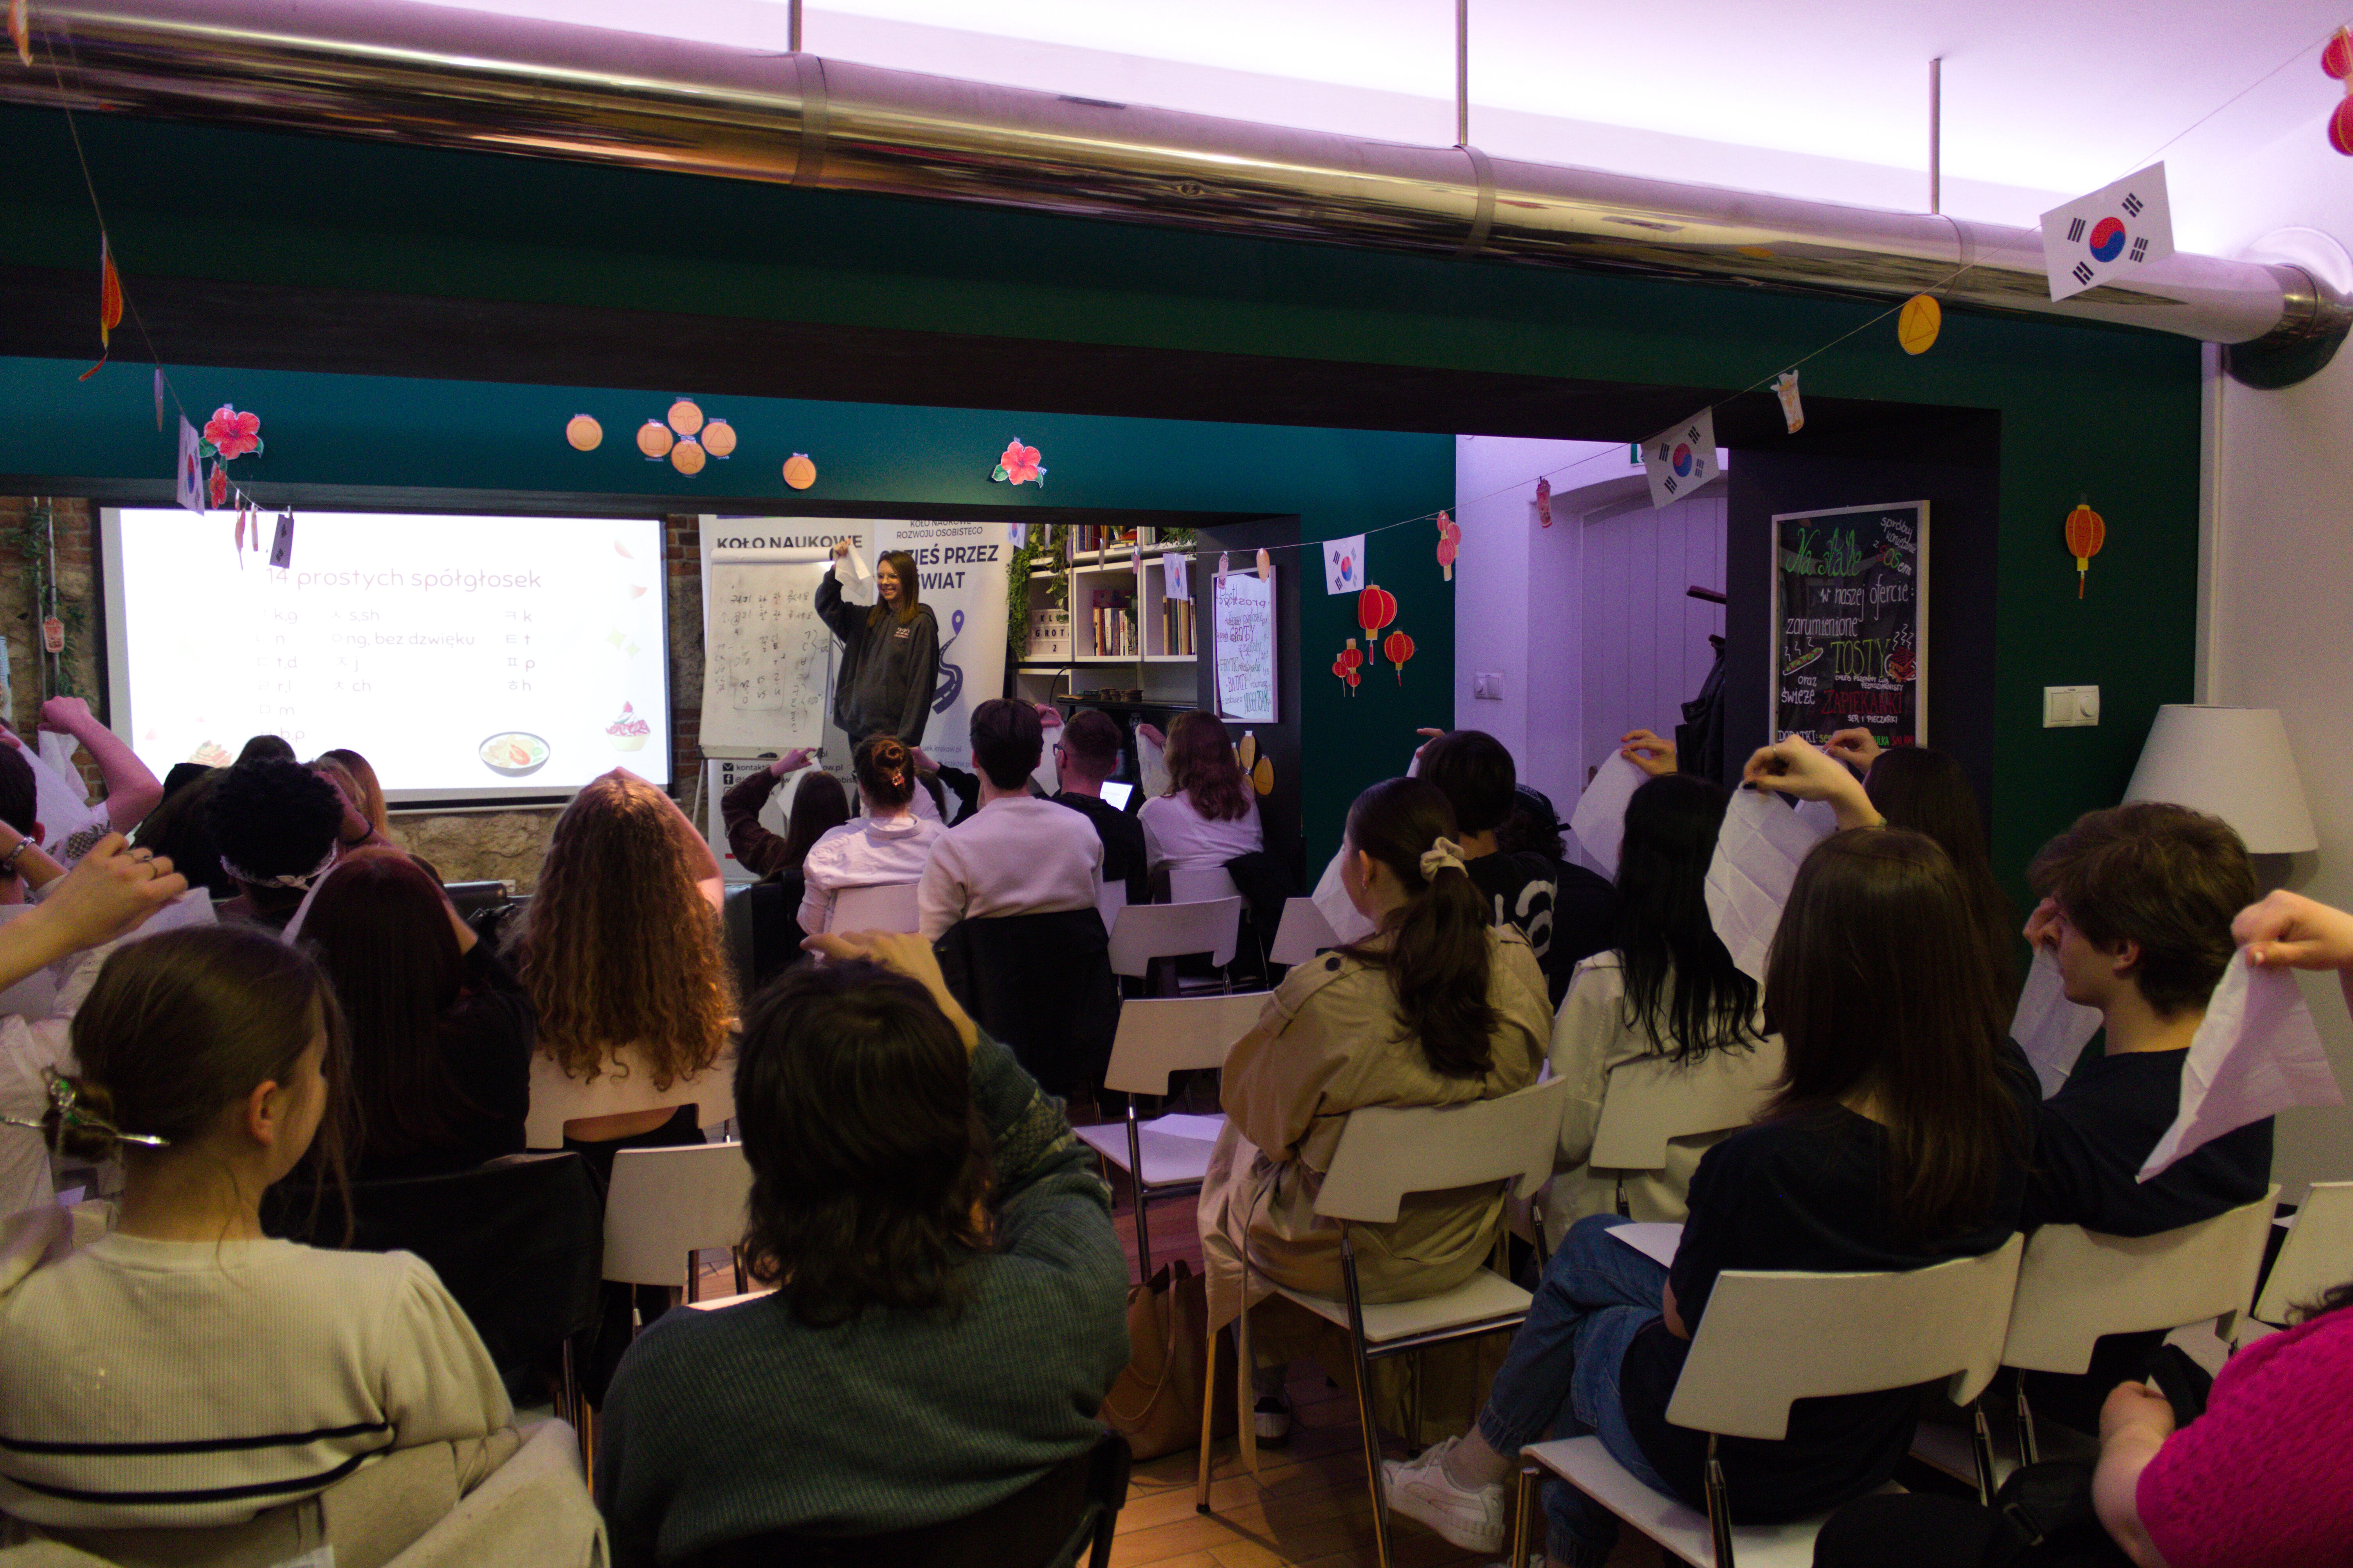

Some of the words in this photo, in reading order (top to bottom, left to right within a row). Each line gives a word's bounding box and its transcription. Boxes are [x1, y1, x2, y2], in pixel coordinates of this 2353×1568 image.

[897, 529, 934, 539] ROZWOJU
[936, 527, 983, 537] OSOBISTEGO
[717, 537, 765, 548] KOŁO
[770, 535, 862, 548] NAUKOWE
[880, 544, 939, 565] IEŚ
[944, 545, 999, 564] PRZEZ
[1786, 527, 1820, 576] Na
[266, 568, 288, 585] 14
[297, 568, 404, 590] prostych
[411, 568, 541, 592] spółgłosek
[917, 572, 965, 590] WIAT
[1835, 584, 1865, 622] naszej
[523, 609, 533, 623] k
[1786, 617, 1858, 637] zarumienione
[276, 635, 285, 644] n
[375, 632, 404, 645] bez
[409, 632, 475, 648] dzwięku
[524, 634, 531, 646] t
[525, 659, 535, 672] p
[1831, 638, 1891, 678] TOSTY
[352, 679, 371, 692] ch
[522, 679, 531, 691] h
[1228, 673, 1247, 693] BATATY
[1798, 676, 1817, 686] oraz
[1781, 687, 1815, 705] świeże
[1821, 689, 1902, 714] ZAPIEKANKI
[279, 707, 295, 716] m
[1847, 714, 1859, 723] SER
[1867, 715, 1898, 724] PIECZARKI
[1778, 730, 1818, 743] DOTKI:
[1873, 736, 1890, 746] ULKA
